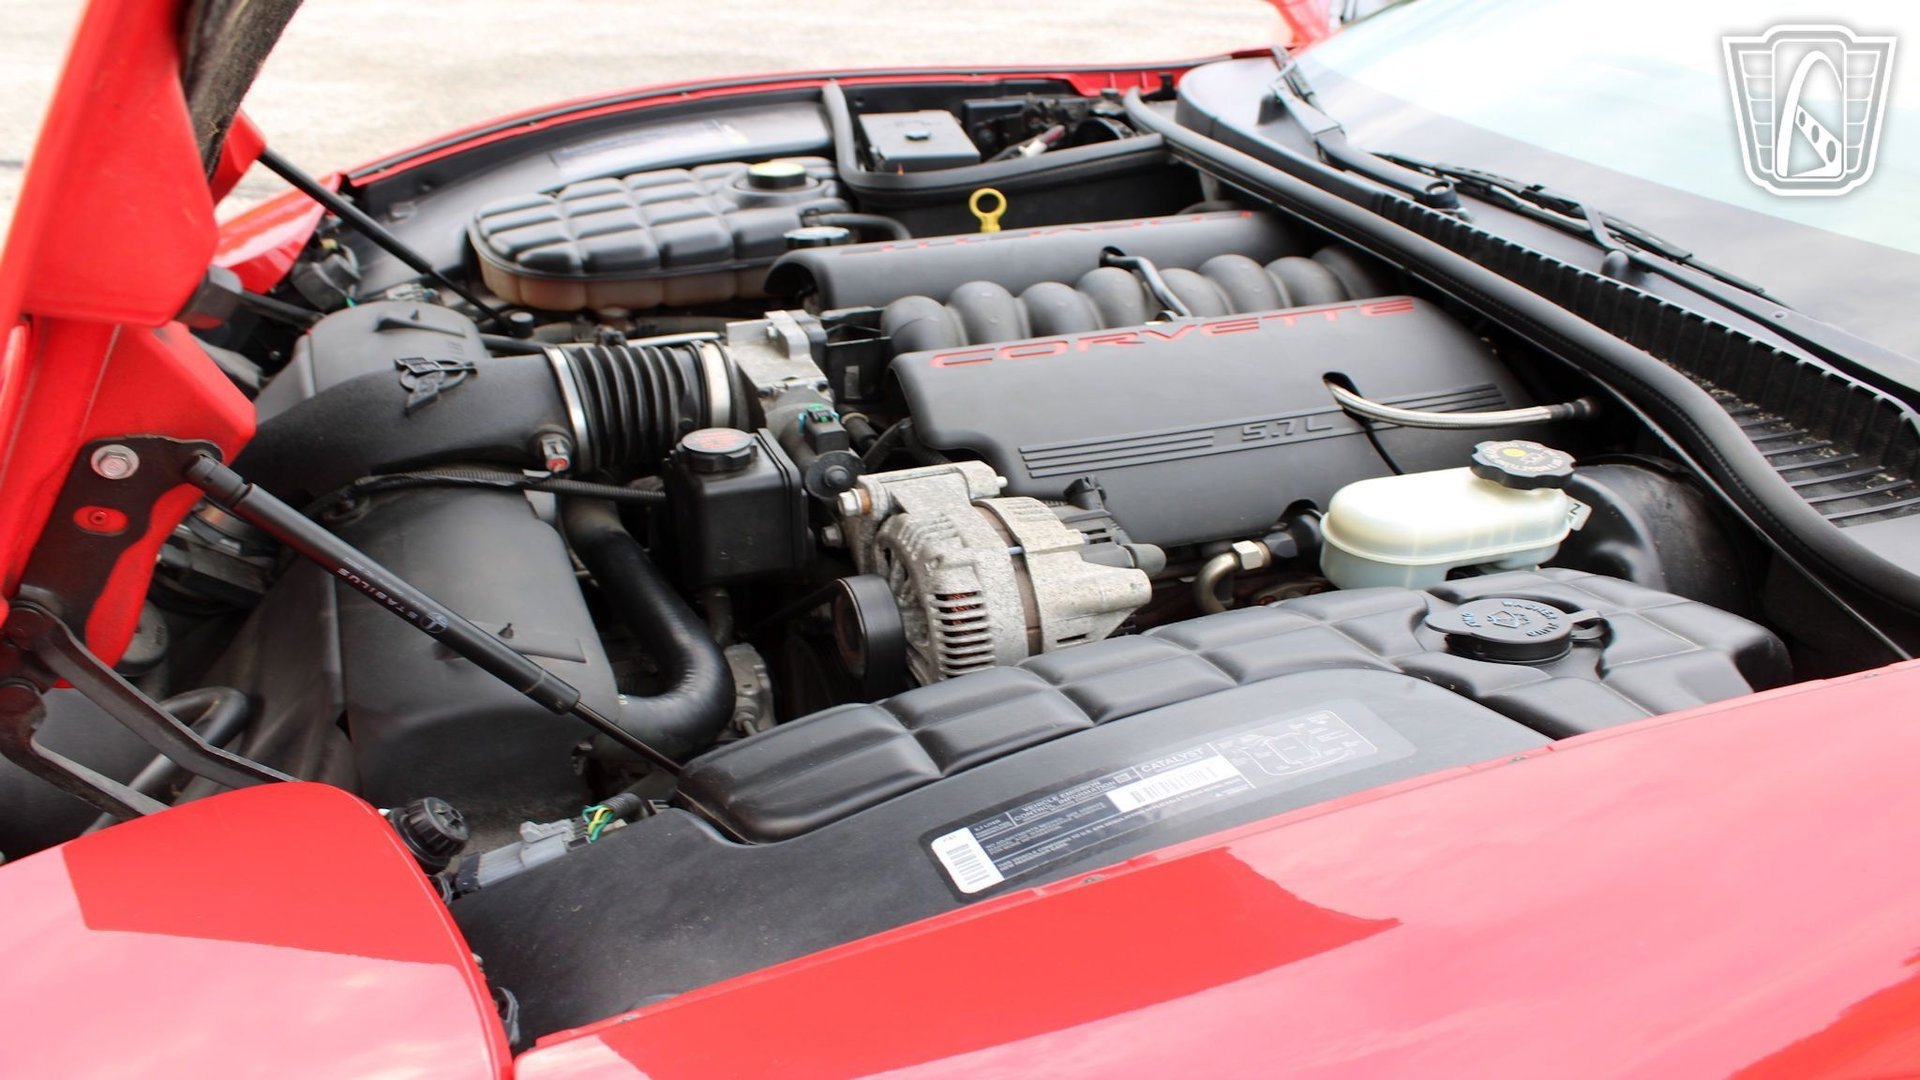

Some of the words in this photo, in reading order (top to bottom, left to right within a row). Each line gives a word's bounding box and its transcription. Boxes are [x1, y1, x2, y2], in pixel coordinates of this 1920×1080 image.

[930, 297, 1416, 368] CORVETTE
[337, 567, 419, 621] STABILUS
[1139, 746, 1206, 773] CATALYST
